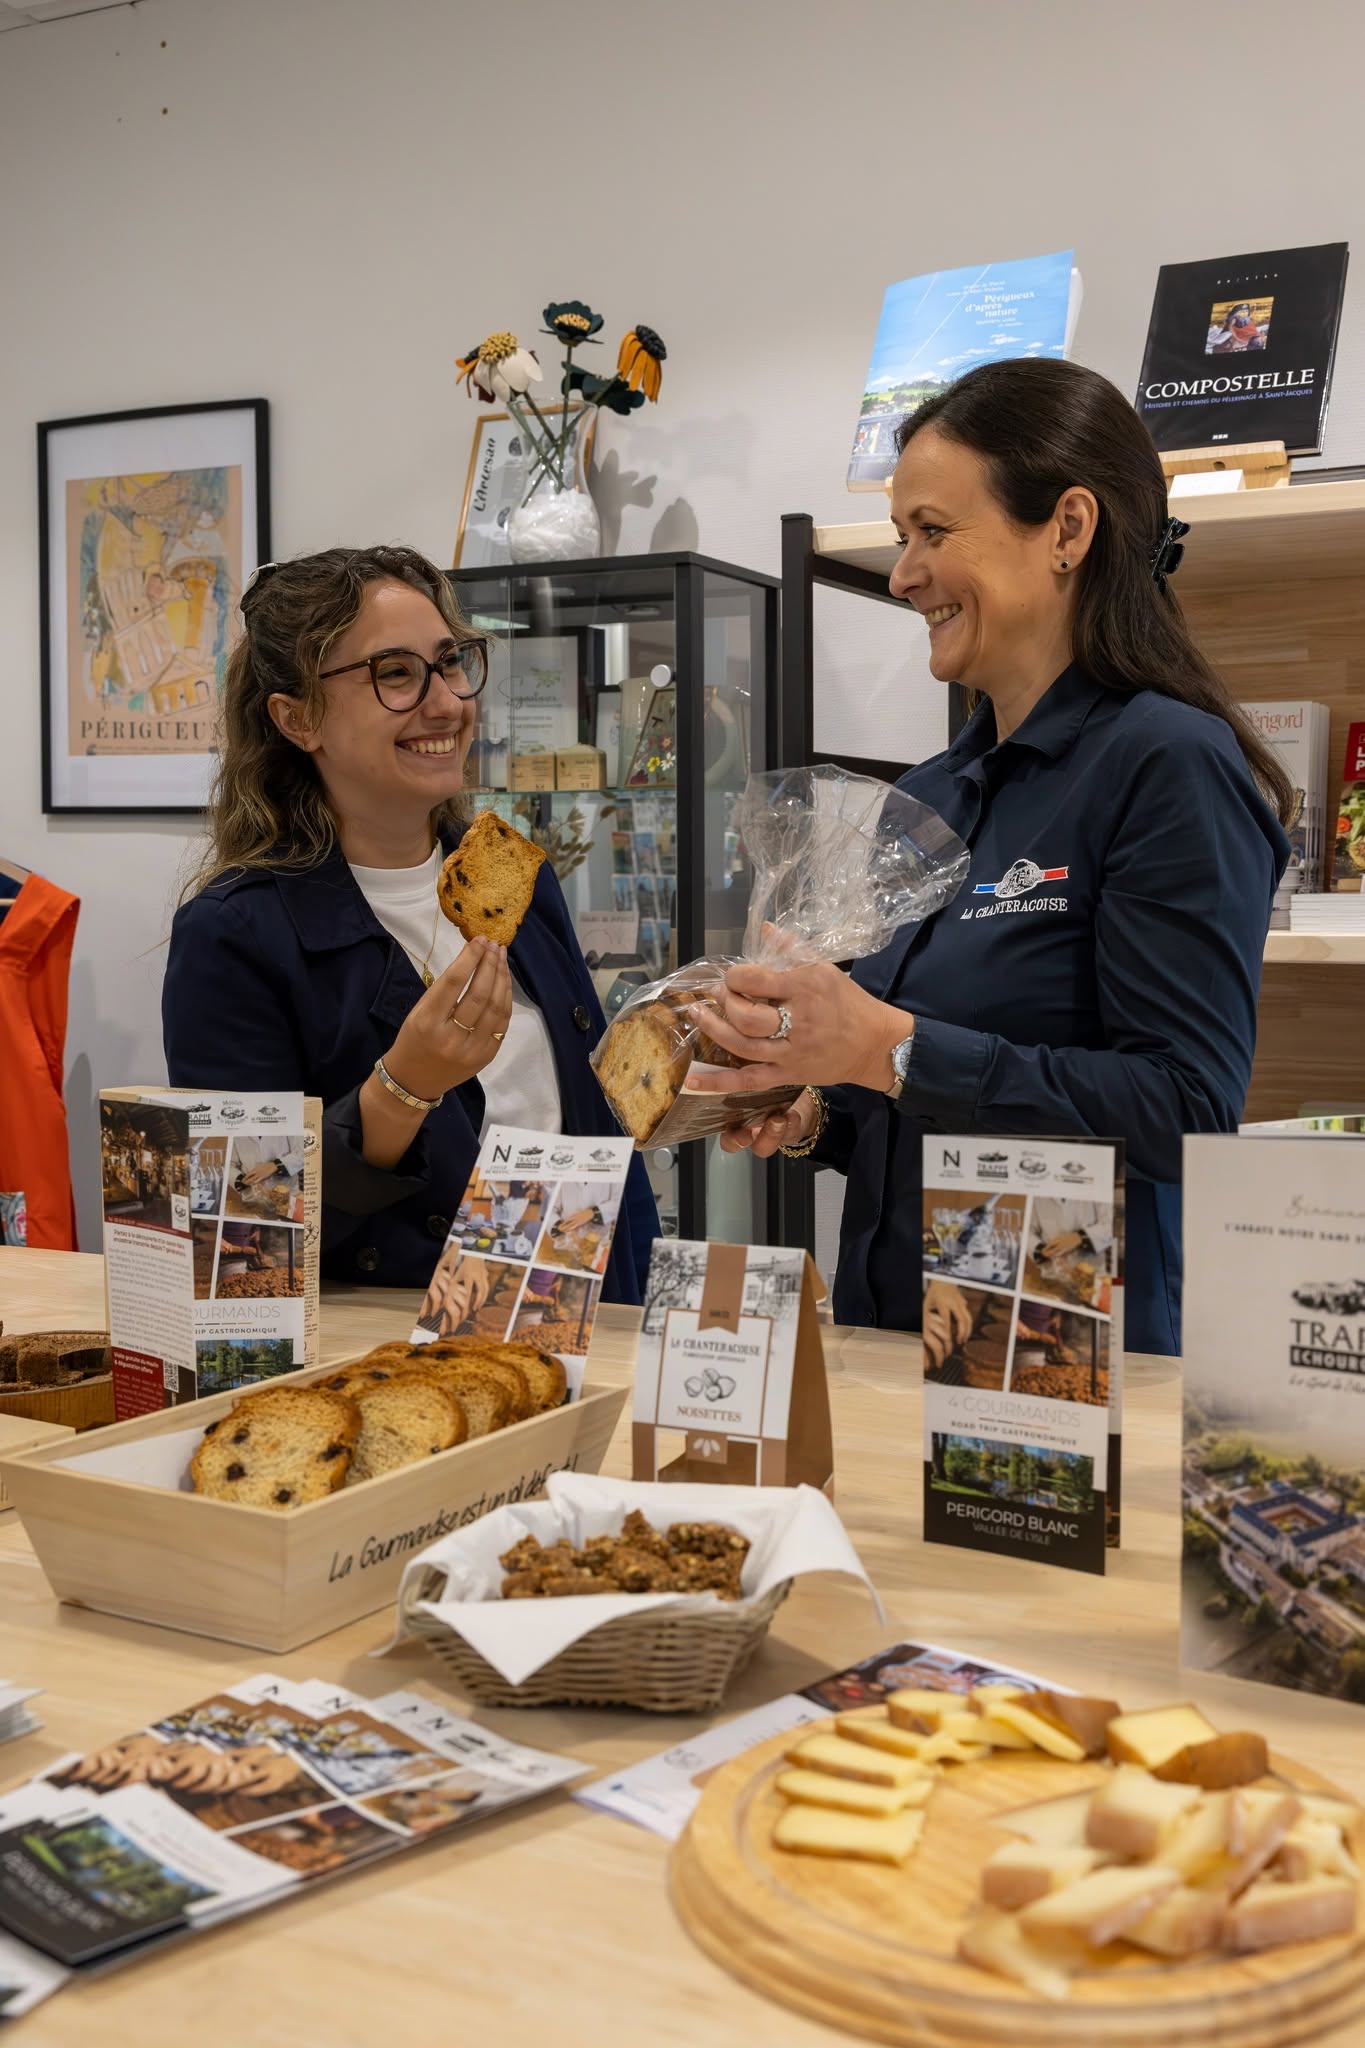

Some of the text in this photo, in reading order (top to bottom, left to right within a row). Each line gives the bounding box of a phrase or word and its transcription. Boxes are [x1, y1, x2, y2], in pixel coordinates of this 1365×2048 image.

[985, 291, 1035, 303] Périgueux
[965, 303, 1002, 313] d'après
[985, 308, 1017, 318] nature
[1145, 368, 1315, 399] COMPOSTELLE
[959, 897, 1068, 920] LA CHANTERACOISE
[492, 1145, 512, 1163] N
[943, 1149, 960, 1168] N
[195, 1305, 281, 1320] URMANDS
[208, 1327, 277, 1335] GASTRONOMIQUE
[683, 1338, 760, 1356] CHANTERACOISE
[677, 1405, 743, 1423] NOISETTES
[962, 1395, 1081, 1429] GOURMANDS
[951, 1420, 1078, 1446] ROAD TRIP GASTRONOMIQUE
[945, 1501, 1080, 1539] PERIGORD BLANC
[1009, 1528, 1022, 1539] DE
[328, 1551, 354, 1583] La
